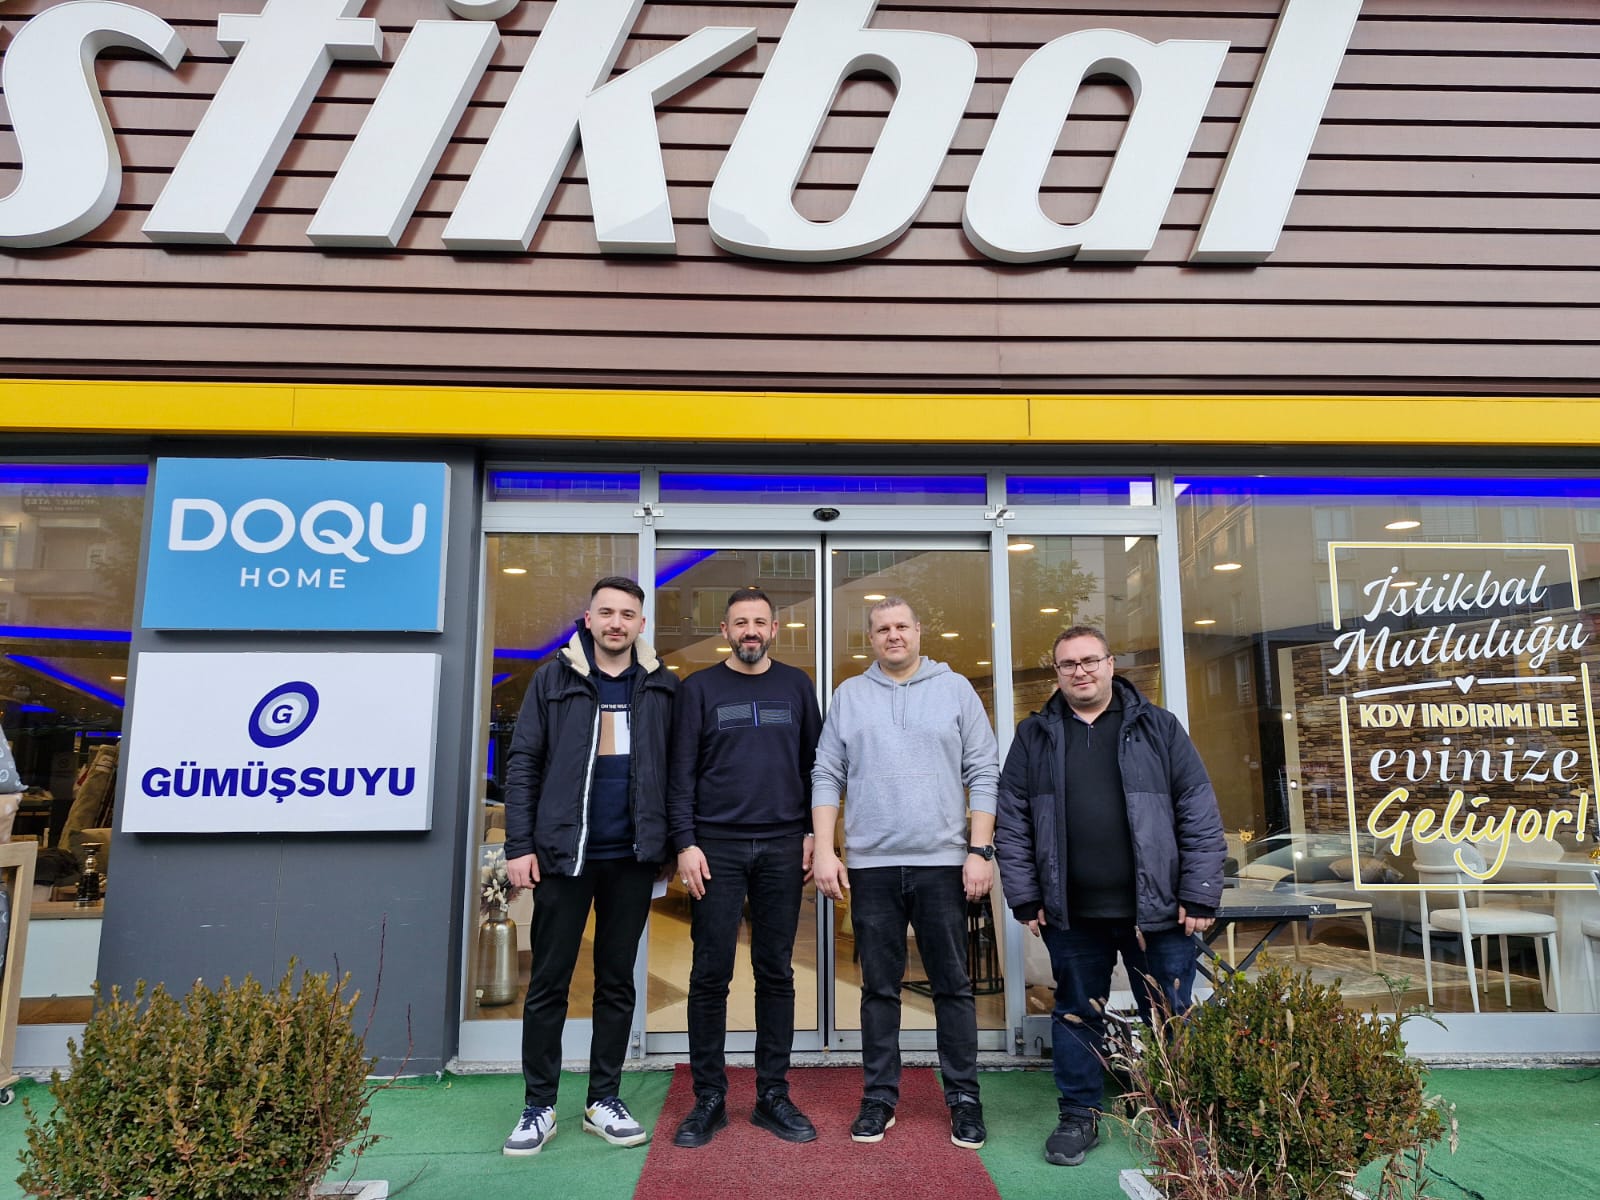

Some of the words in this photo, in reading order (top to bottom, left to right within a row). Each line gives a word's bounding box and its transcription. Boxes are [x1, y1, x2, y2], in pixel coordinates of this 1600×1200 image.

[168, 498, 427, 563] DOQU
[240, 567, 346, 589] HOME
[1363, 564, 1548, 622] İstikbal
[1328, 616, 1590, 676] Mutluluğu
[271, 704, 294, 725] G
[1359, 703, 1415, 728] KDV
[141, 760, 416, 804] GÜMÜŞSUYU
[1370, 737, 1579, 782] evinize
[1367, 787, 1588, 880] Geliyor!
